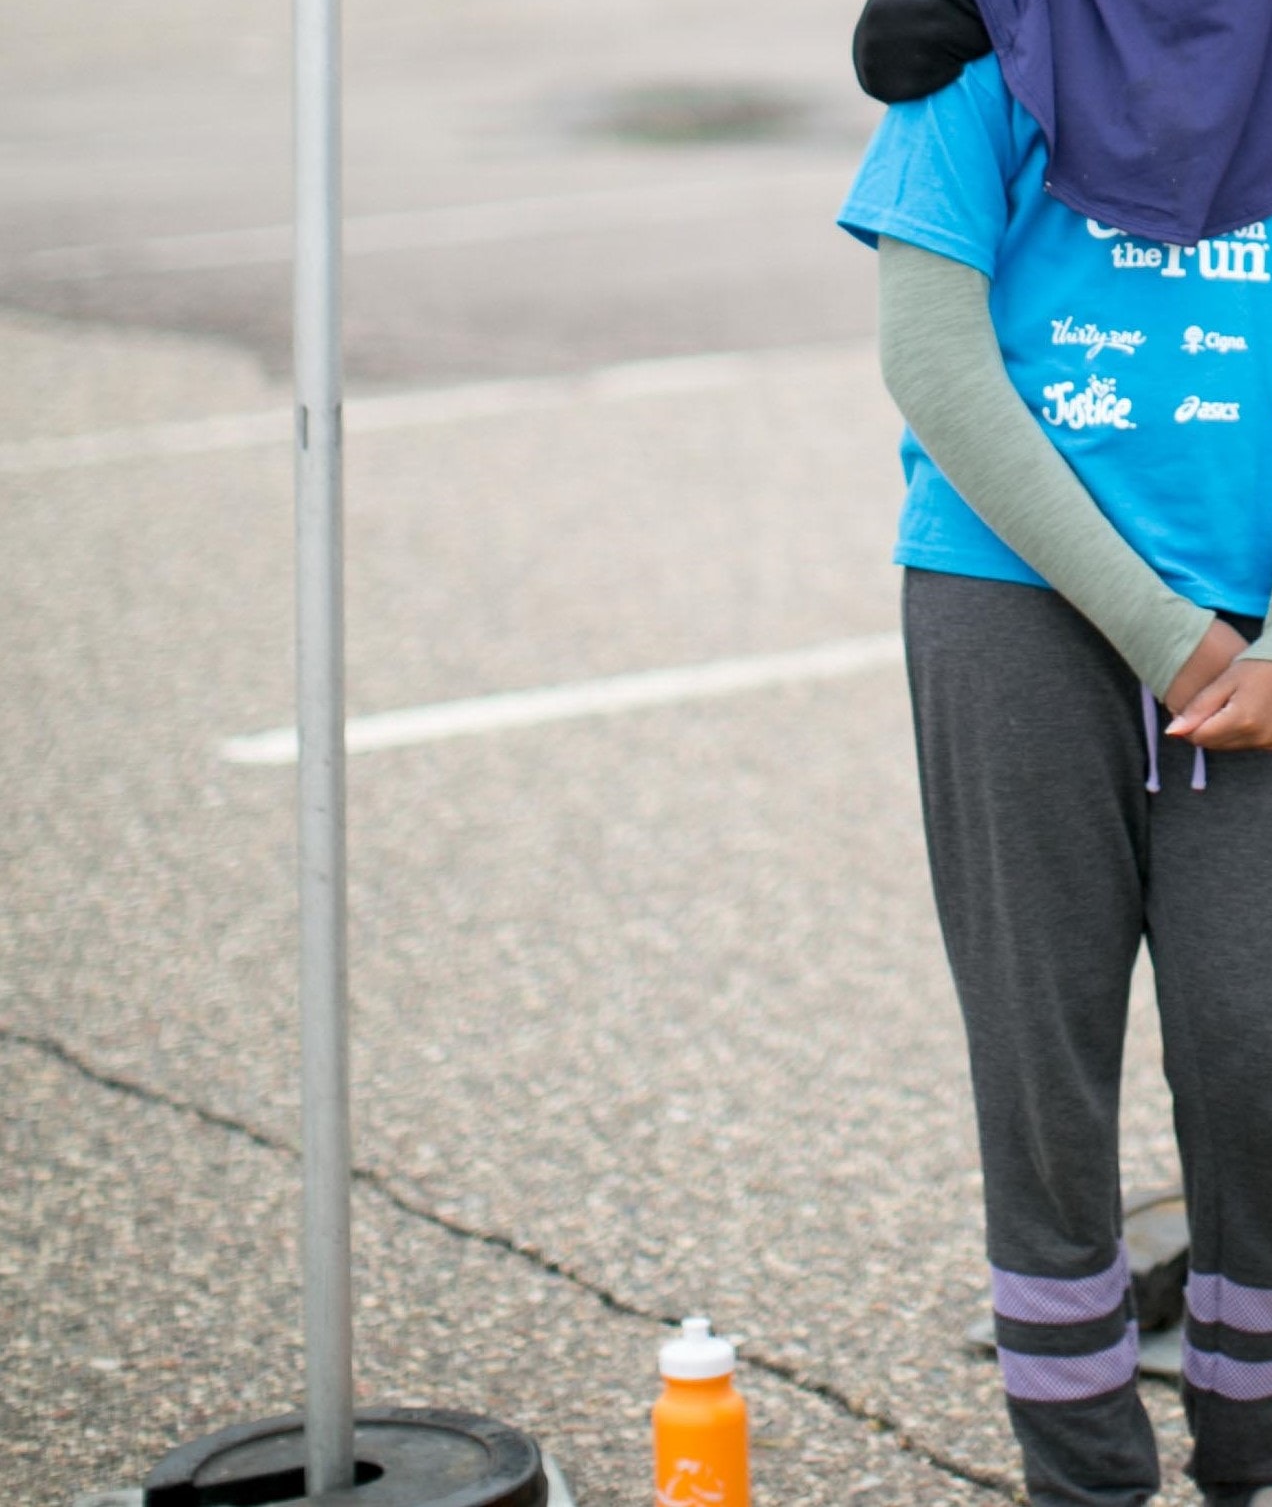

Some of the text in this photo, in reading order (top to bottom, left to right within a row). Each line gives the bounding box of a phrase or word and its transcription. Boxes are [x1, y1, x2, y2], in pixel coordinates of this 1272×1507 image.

[1111, 240, 1272, 282] the run
[1204, 331, 1249, 353] Cigna
[1042, 373, 1137, 429] Justice
